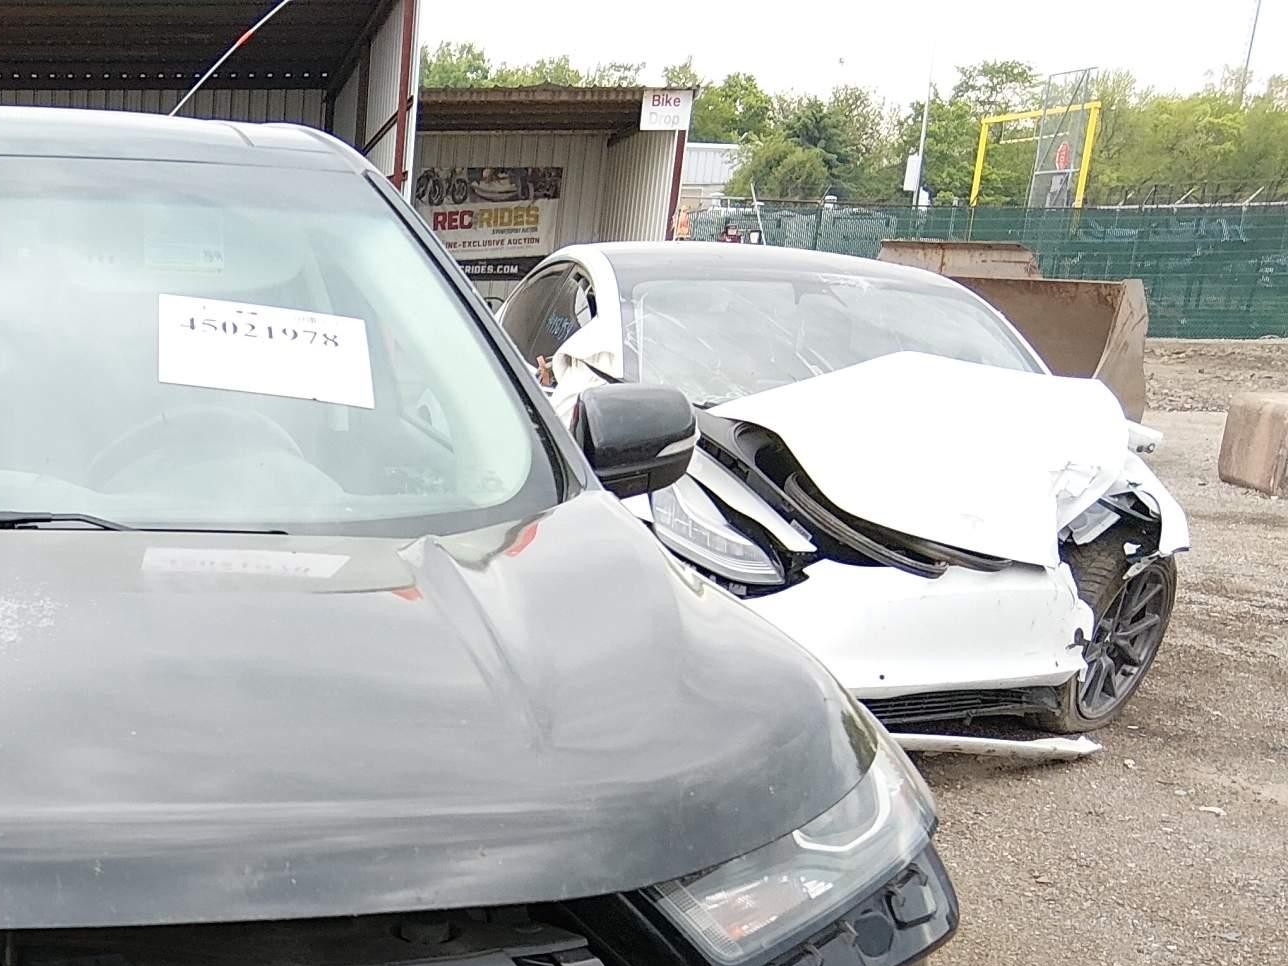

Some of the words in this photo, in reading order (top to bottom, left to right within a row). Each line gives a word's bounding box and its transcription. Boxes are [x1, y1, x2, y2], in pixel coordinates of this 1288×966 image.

[652, 94, 681, 107] Bike
[649, 111, 680, 127] Drop
[433, 210, 474, 231] REC
[479, 206, 540, 228] RIDES
[507, 238, 540, 246] AUCTION
